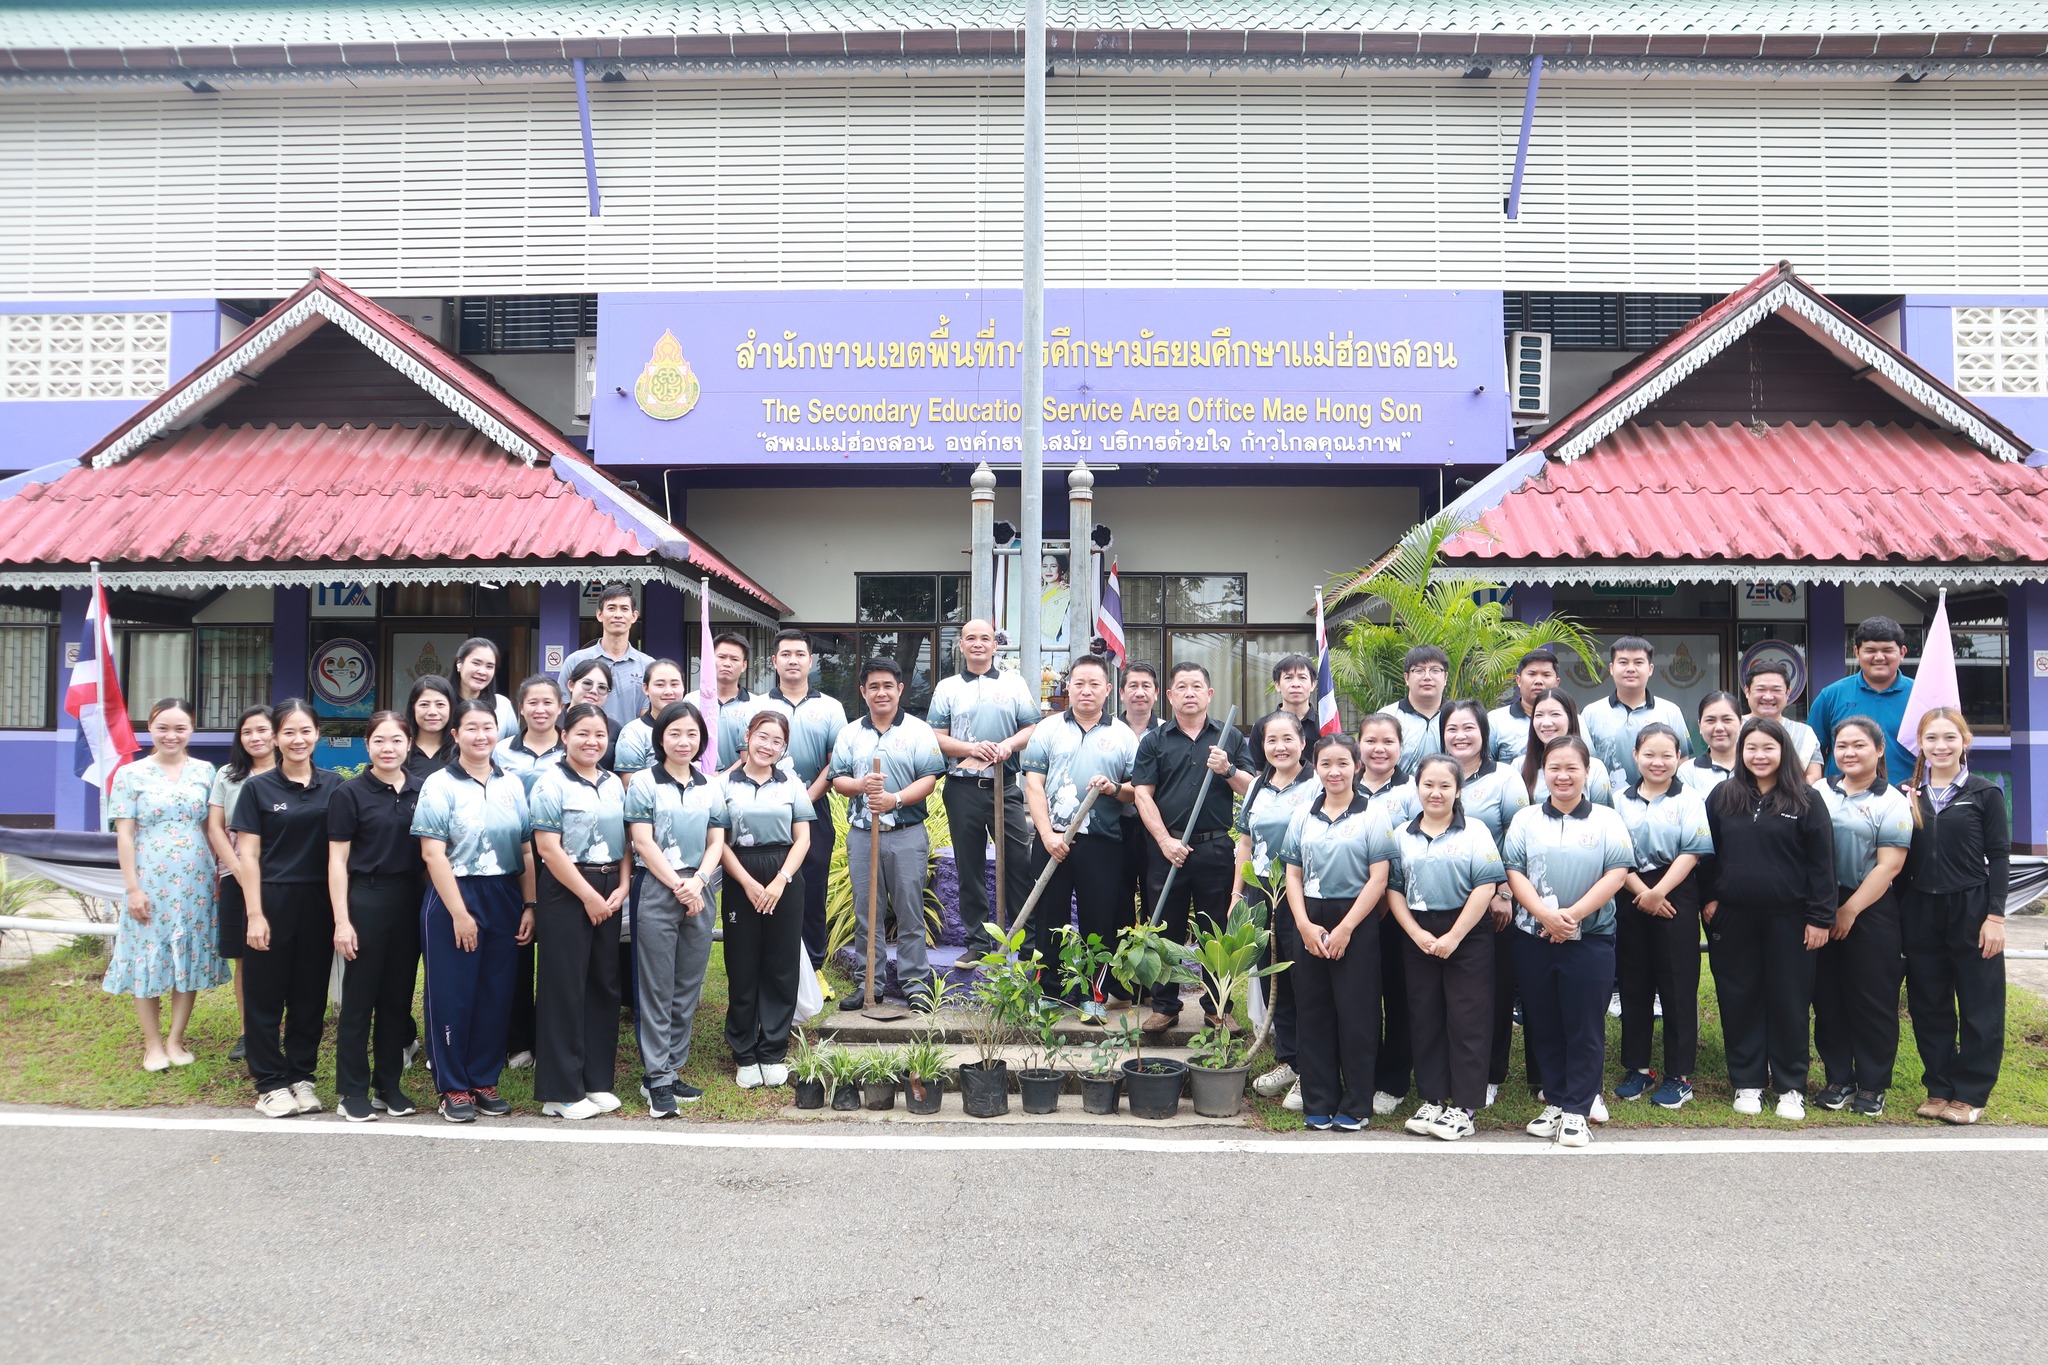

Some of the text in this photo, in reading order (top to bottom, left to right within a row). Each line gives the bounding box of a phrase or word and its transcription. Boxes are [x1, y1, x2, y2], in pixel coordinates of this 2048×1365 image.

[735, 314, 1458, 369] สำนักงานเขตพื้นที่กศึกษามัธยมศึกษาแม่ฮ่องสอน
[762, 396, 1422, 429] The Secondary Educatio Service Area Office Mae Hong Son
[945, 428, 1092, 452] องค์กรทสมัย
[1099, 428, 1232, 452] บริการด้วยใจ
[318, 580, 372, 606] ITA
